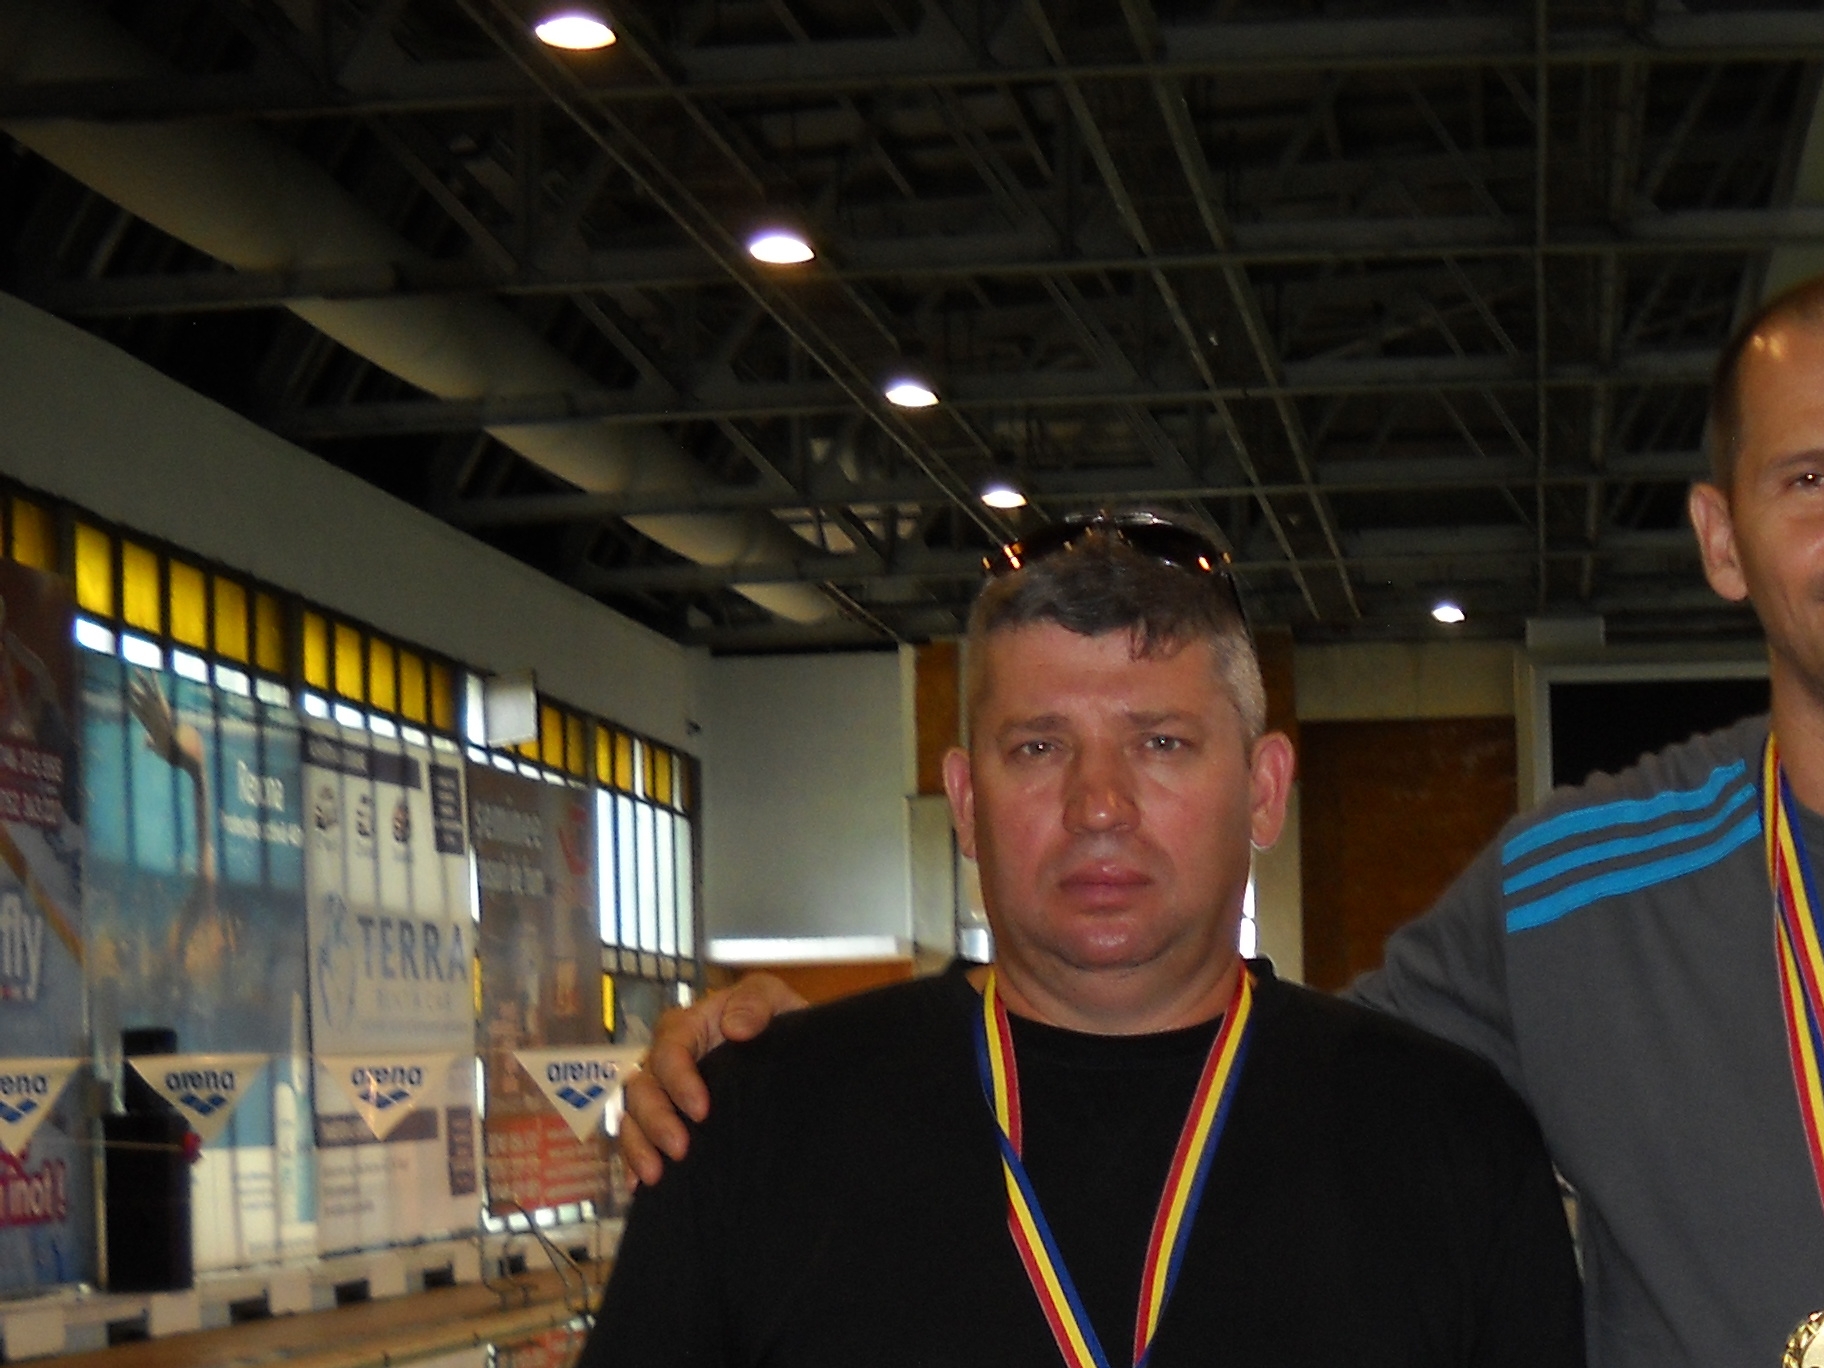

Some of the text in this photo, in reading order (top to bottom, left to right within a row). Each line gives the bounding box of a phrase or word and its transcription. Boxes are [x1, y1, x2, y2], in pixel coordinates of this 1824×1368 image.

[357, 915, 468, 981] TERRA
[165, 1070, 235, 1091] arena
[352, 1066, 424, 1087] arena
[547, 1061, 619, 1084] arena
[0, 1074, 48, 1096] ena
